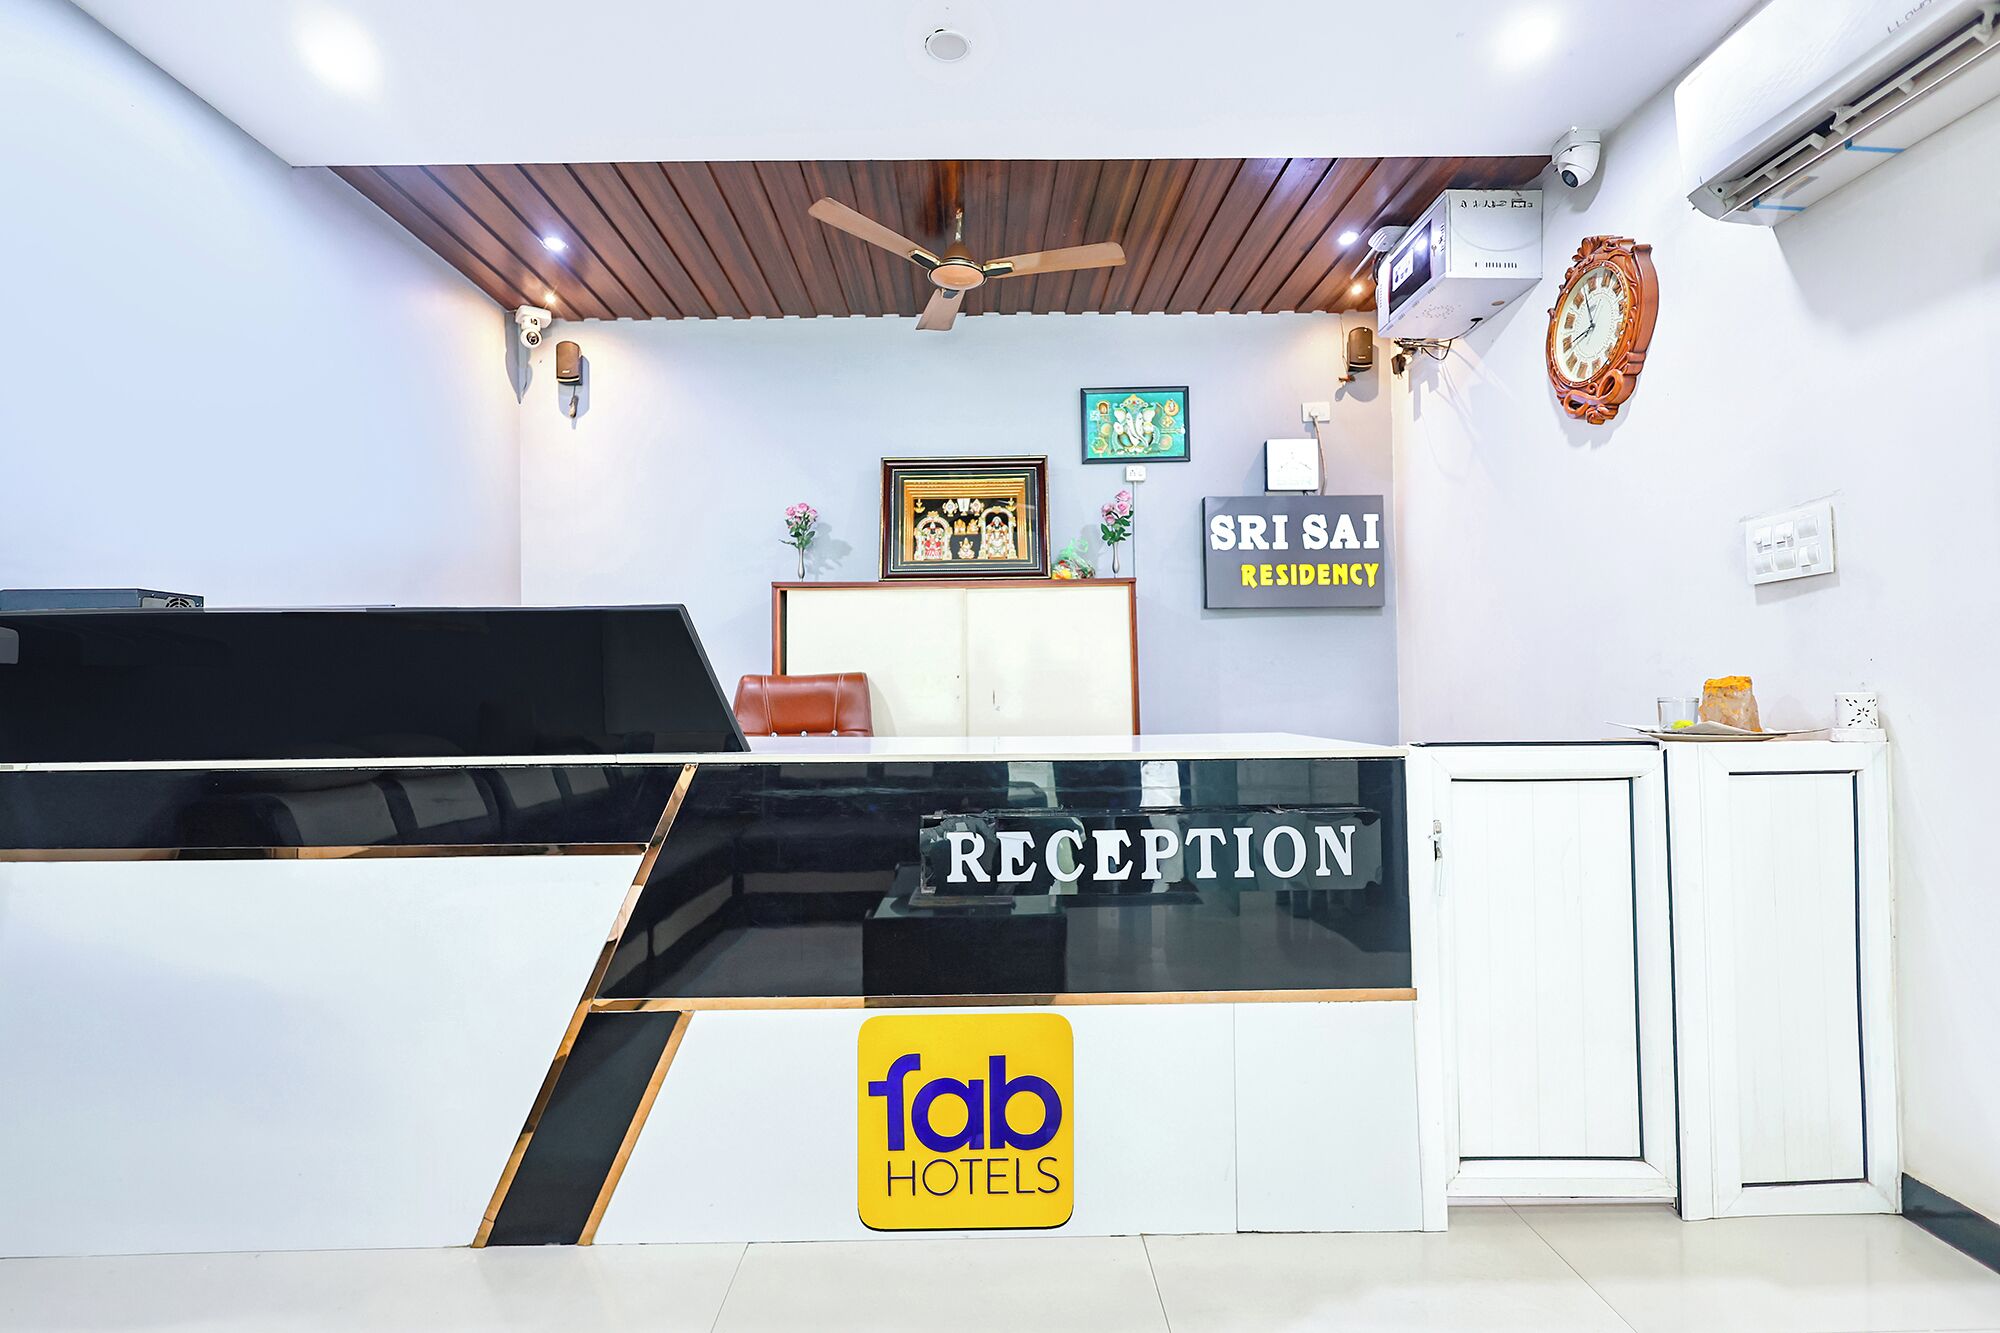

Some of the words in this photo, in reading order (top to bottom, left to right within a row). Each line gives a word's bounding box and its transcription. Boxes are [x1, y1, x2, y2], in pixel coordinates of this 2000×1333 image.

[1209, 513, 1289, 551] SRI
[1302, 513, 1380, 550] SAI
[1240, 562, 1379, 589] RESIDENCY
[945, 824, 1356, 883] RECEPTION
[868, 1053, 1063, 1153] fab
[887, 1156, 1060, 1197] HOTELS
